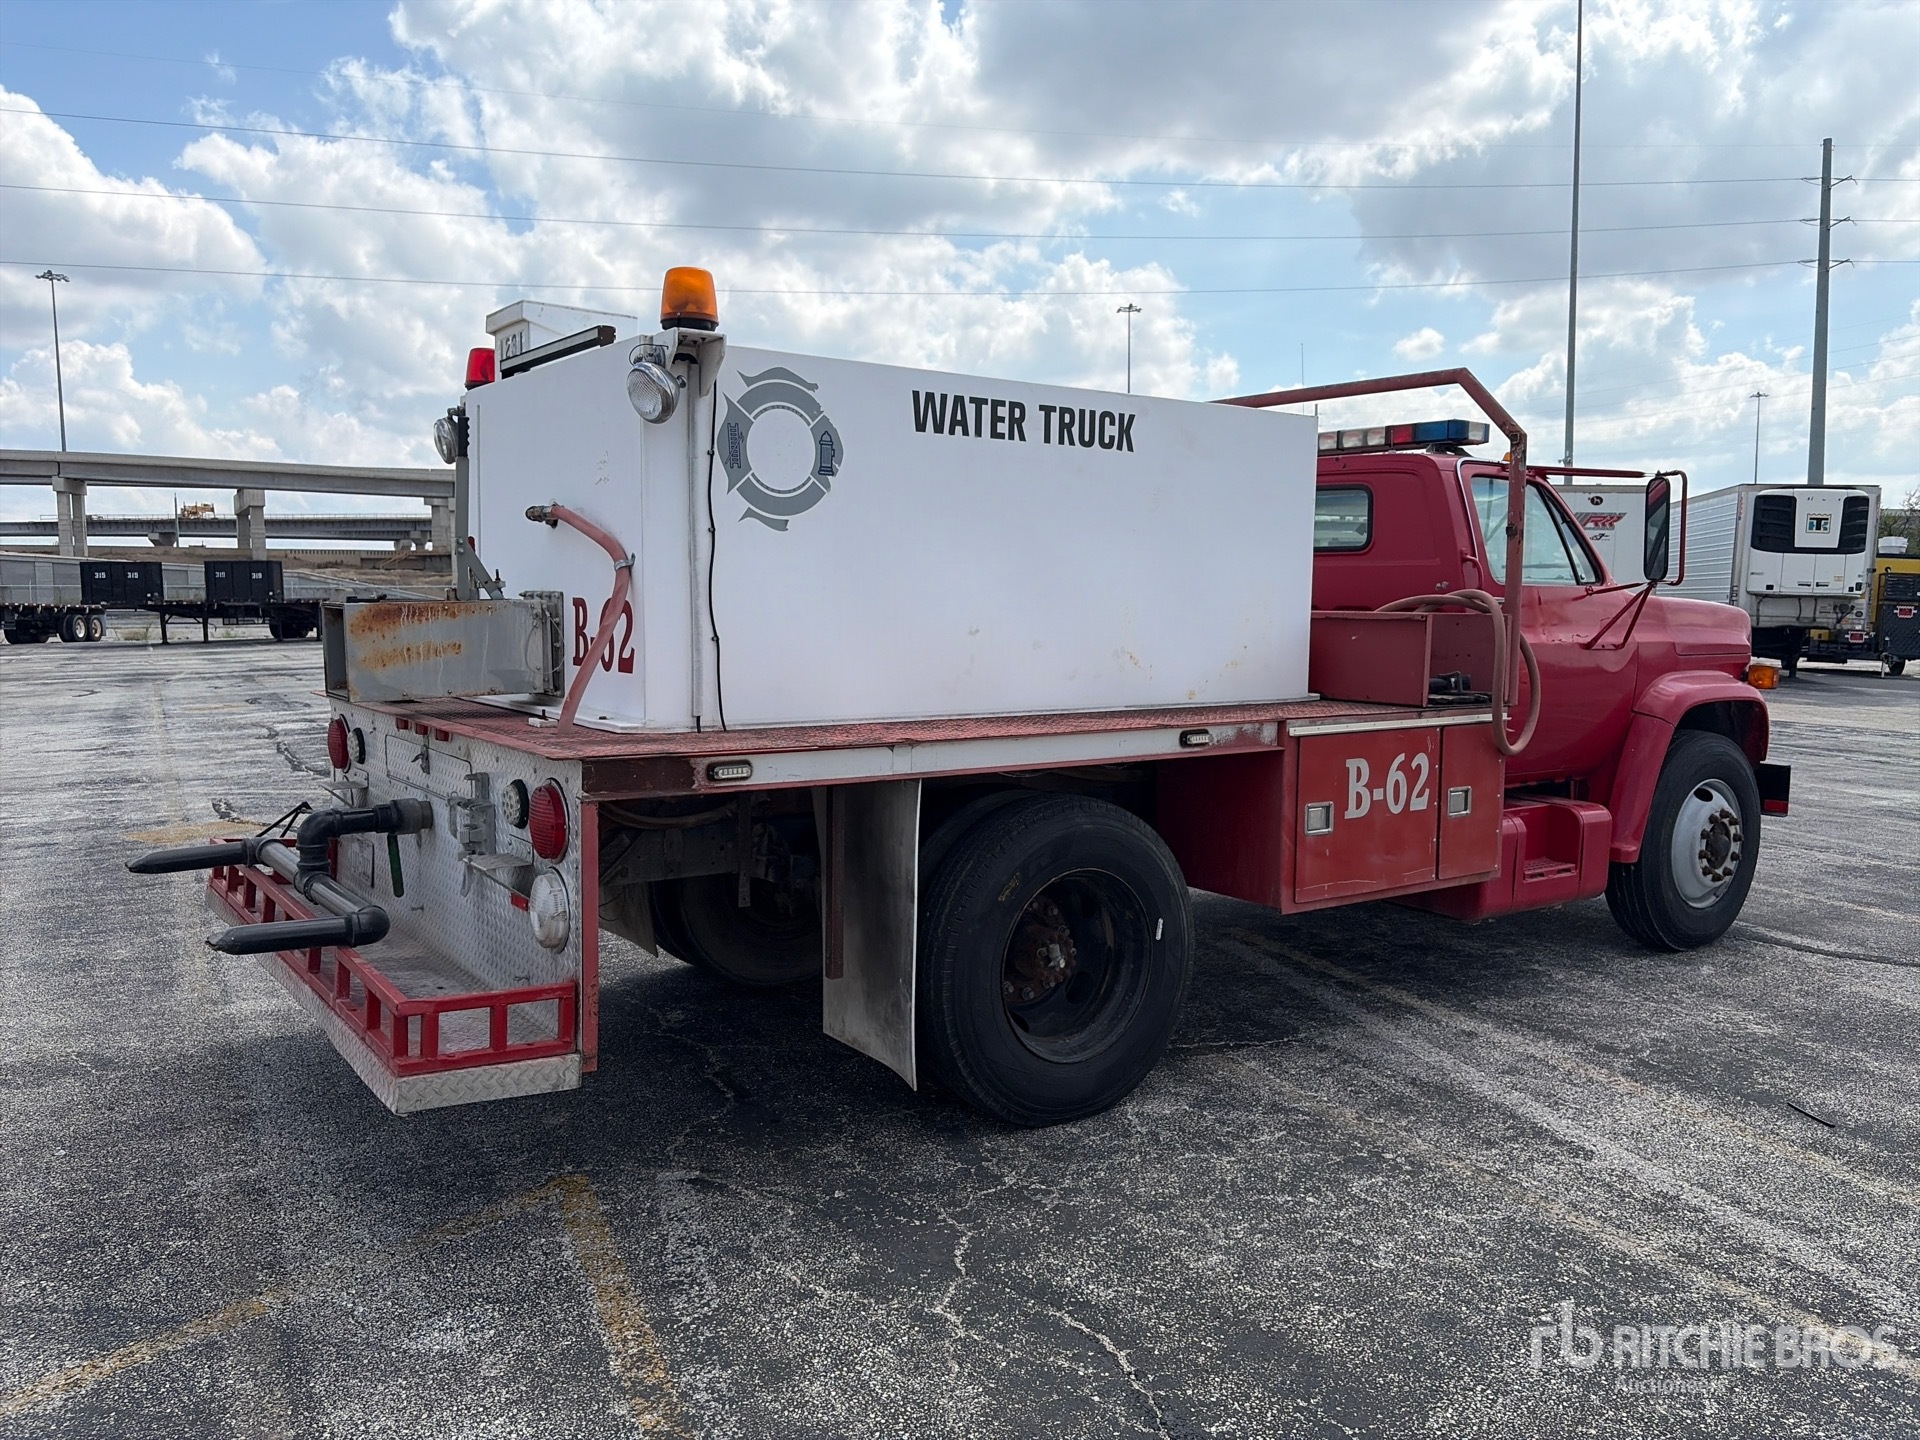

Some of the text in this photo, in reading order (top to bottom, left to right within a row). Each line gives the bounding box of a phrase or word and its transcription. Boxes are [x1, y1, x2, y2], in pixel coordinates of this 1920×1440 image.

[911, 389, 1136, 453] WATER TRUCK
[1344, 752, 1430, 819] B-62
